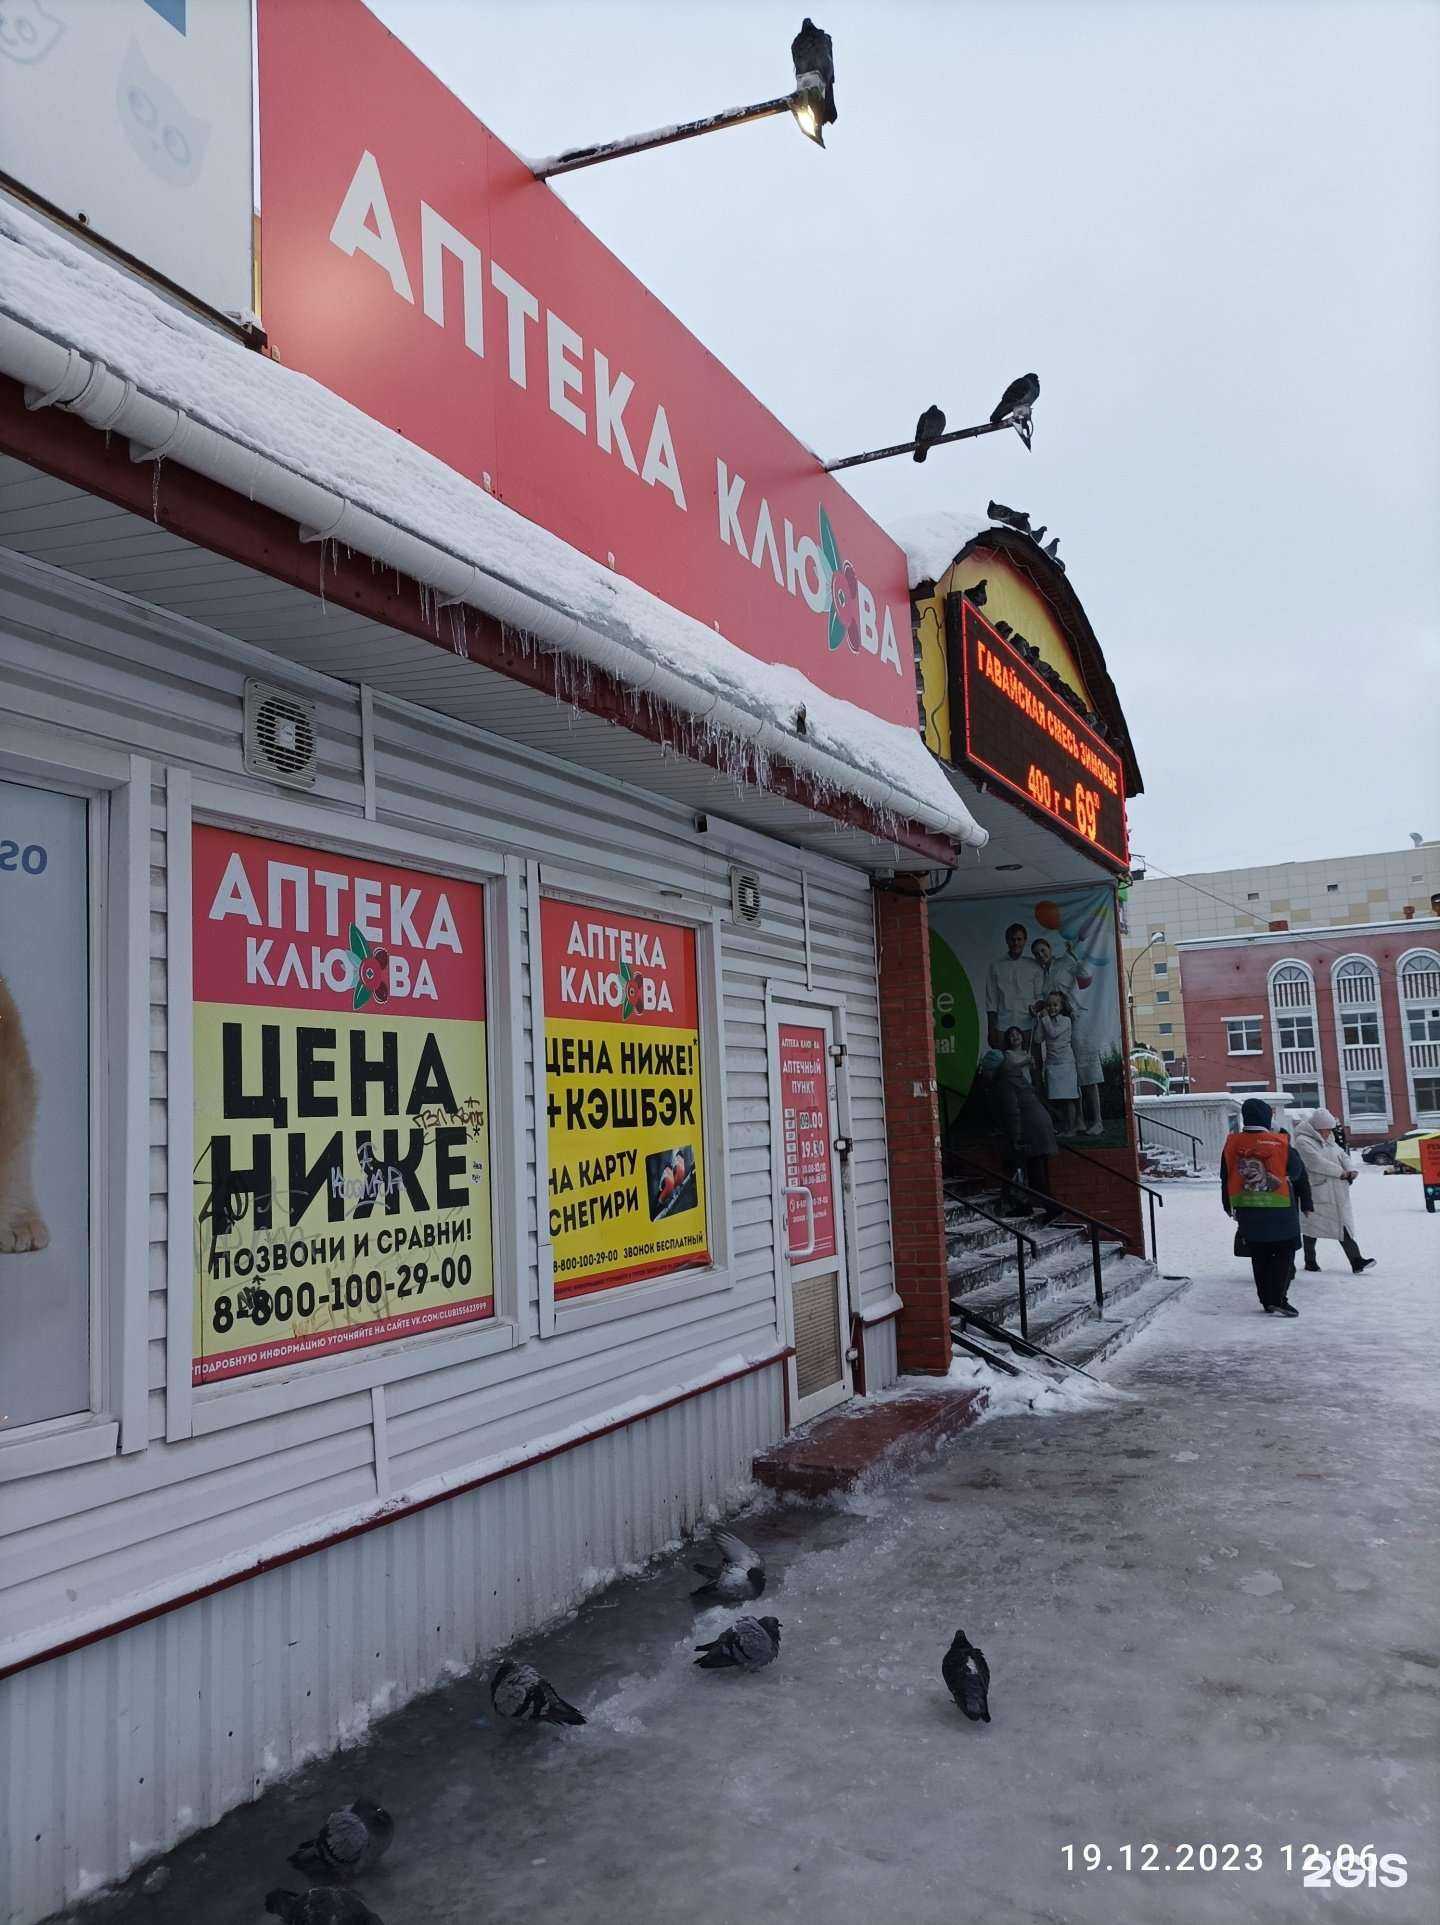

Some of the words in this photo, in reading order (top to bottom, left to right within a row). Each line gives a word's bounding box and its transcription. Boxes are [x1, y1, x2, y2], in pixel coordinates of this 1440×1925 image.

[329, 150, 687, 512] АПТЕКА
[977, 640, 1047, 730] ГАВАЙСКАЯ
[1047, 711, 1079, 759] СМЕСЬ
[1027, 764, 1051, 806] 400
[208, 852, 463, 954] АПТЕКА
[567, 921, 667, 970] АПТЕКА
[223, 1022, 458, 1129] ЦЕНА
[545, 1037, 613, 1076] ЦЕНА
[547, 1088, 695, 1130] +КЭШБЭК
[211, 1127, 470, 1236] НИЖЕ
[548, 1164, 573, 1196] НА
[579, 1149, 638, 1188] КАРТУ
[549, 1186, 639, 1237] СНЕГИРИ
[213, 1236, 345, 1280] ПОЗВОНИ
[354, 1233, 369, 1258] И
[377, 1218, 473, 1254] СРАВНИ!
[624, 1243, 655, 1258] ЗВОНОК
[656, 1231, 703, 1252] БЕСПЛАТНЫЙ
[213, 1254, 473, 1334] 8-800-100-29-00
[260, 1338, 326, 1360] ИНФОРМАЦИЮ
[328, 1327, 373, 1345] УТОЧНЯЙТЕ
[375, 1324, 385, 1336] НА
[386, 1318, 410, 1332] САЙТЕ
